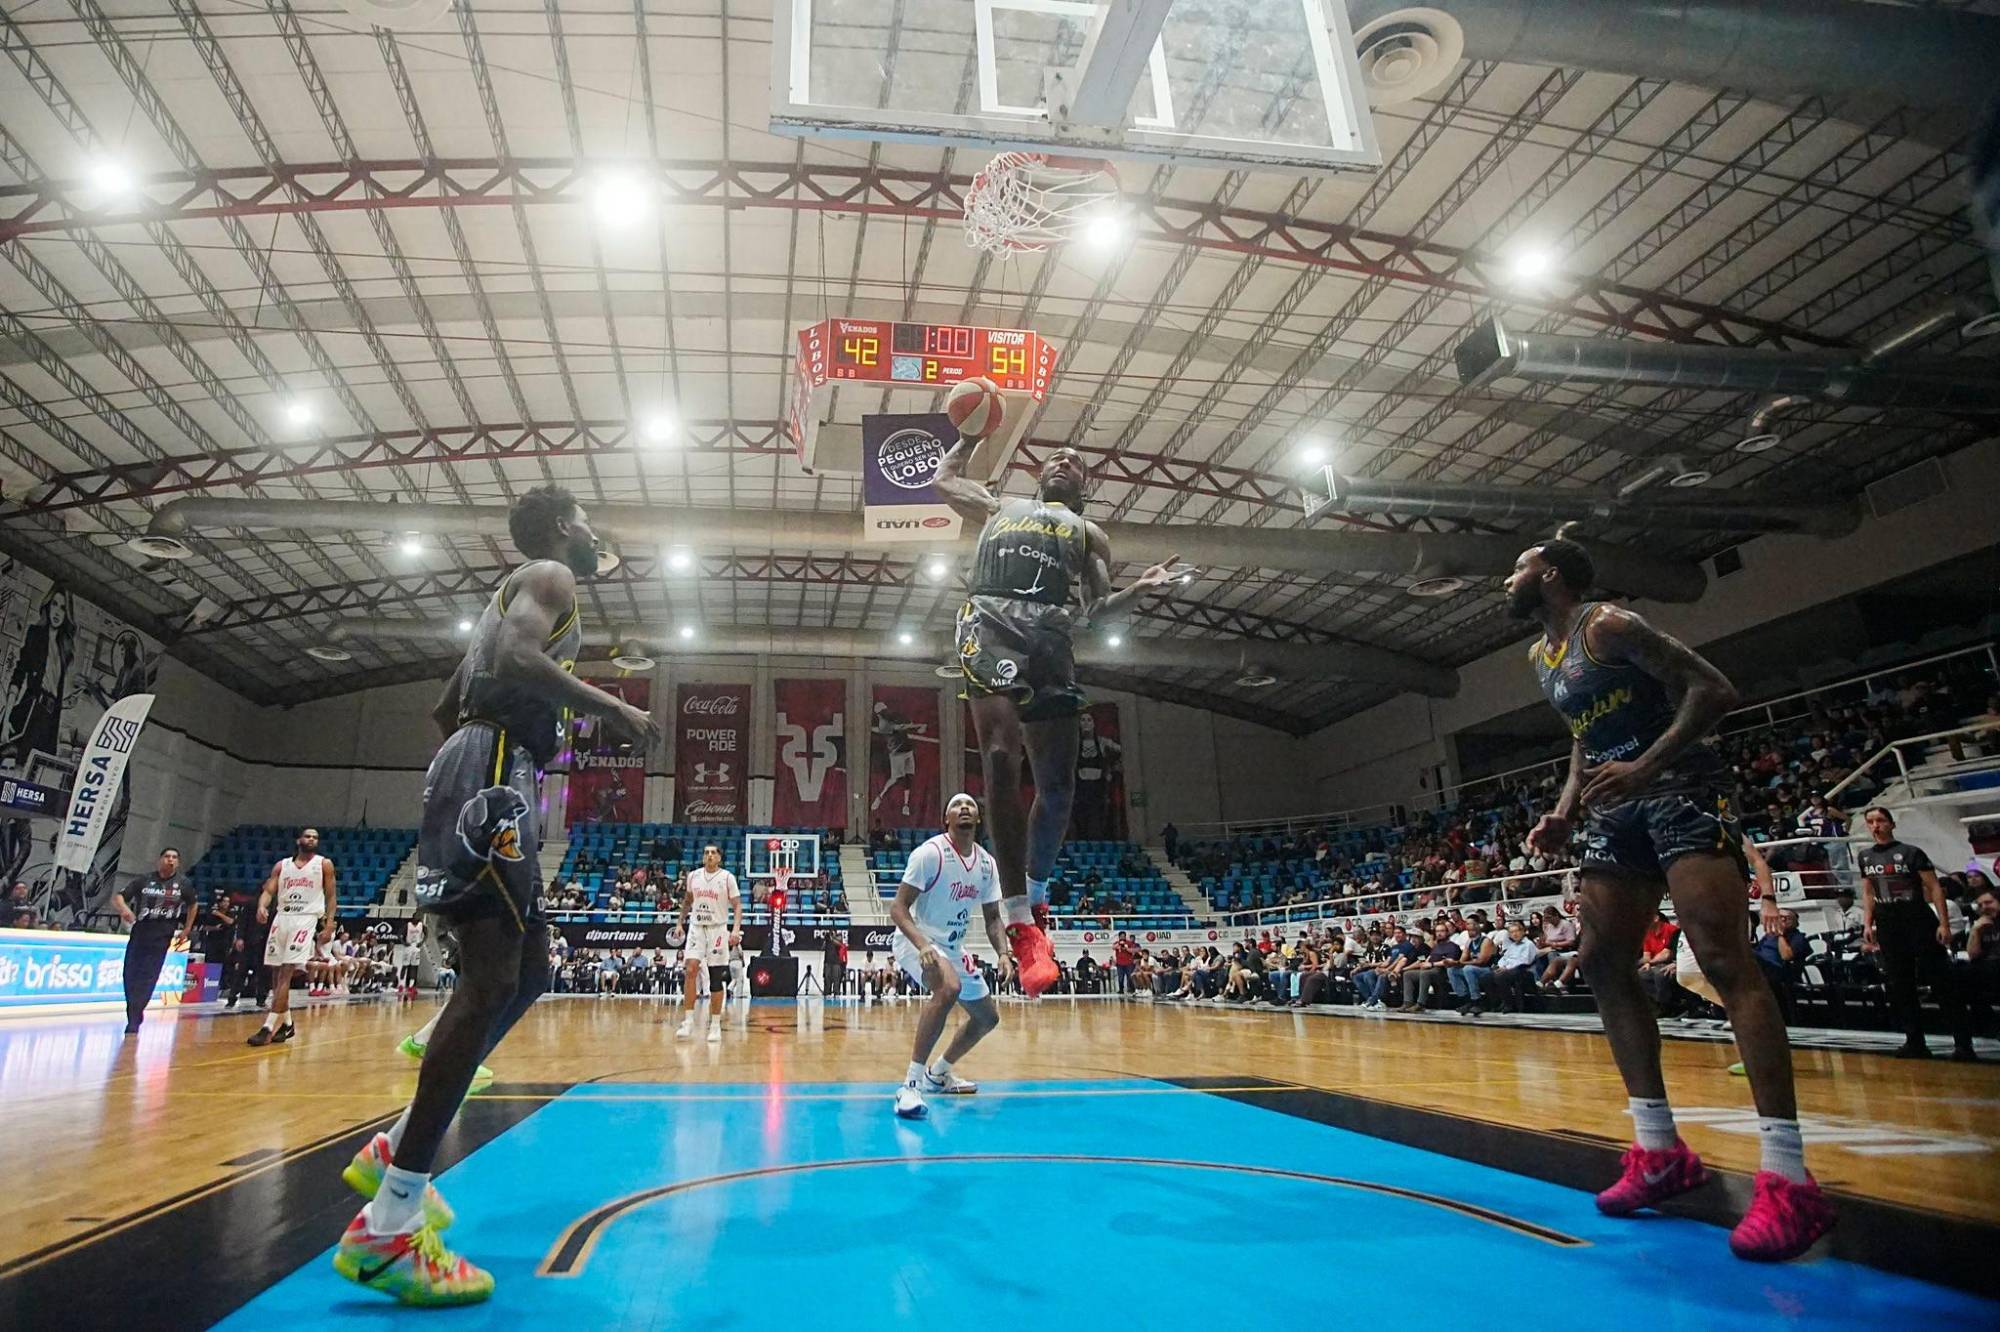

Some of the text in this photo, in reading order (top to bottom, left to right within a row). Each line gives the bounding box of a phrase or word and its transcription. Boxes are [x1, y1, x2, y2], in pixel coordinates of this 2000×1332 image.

[840, 322, 878, 334] VENADOS
[988, 331, 1025, 345] VISITOR
[809, 328, 825, 386] LOBOS
[845, 338, 878, 365] 42
[926, 360, 938, 379] 2
[992, 347, 1025, 375] 54
[942, 366, 963, 375] PERIOD
[877, 438, 942, 468] PEQUEÑO
[887, 435, 921, 453] DESDE
[890, 459, 914, 471] QUIERO
[914, 454, 927, 462] SER
[892, 456, 941, 481] LOBO
[687, 729, 736, 740] POWER
[709, 741, 736, 751] ADE
[575, 748, 644, 770] VENADOS
[16, 787, 45, 802] HERSA
[67, 756, 112, 837] HERSA
[684, 799, 736, 815] Caliente
[293, 930, 309, 943] 13
[585, 929, 648, 942] dportenis
[771, 908, 781, 956] dportenis
[24, 954, 93, 989] brisso
